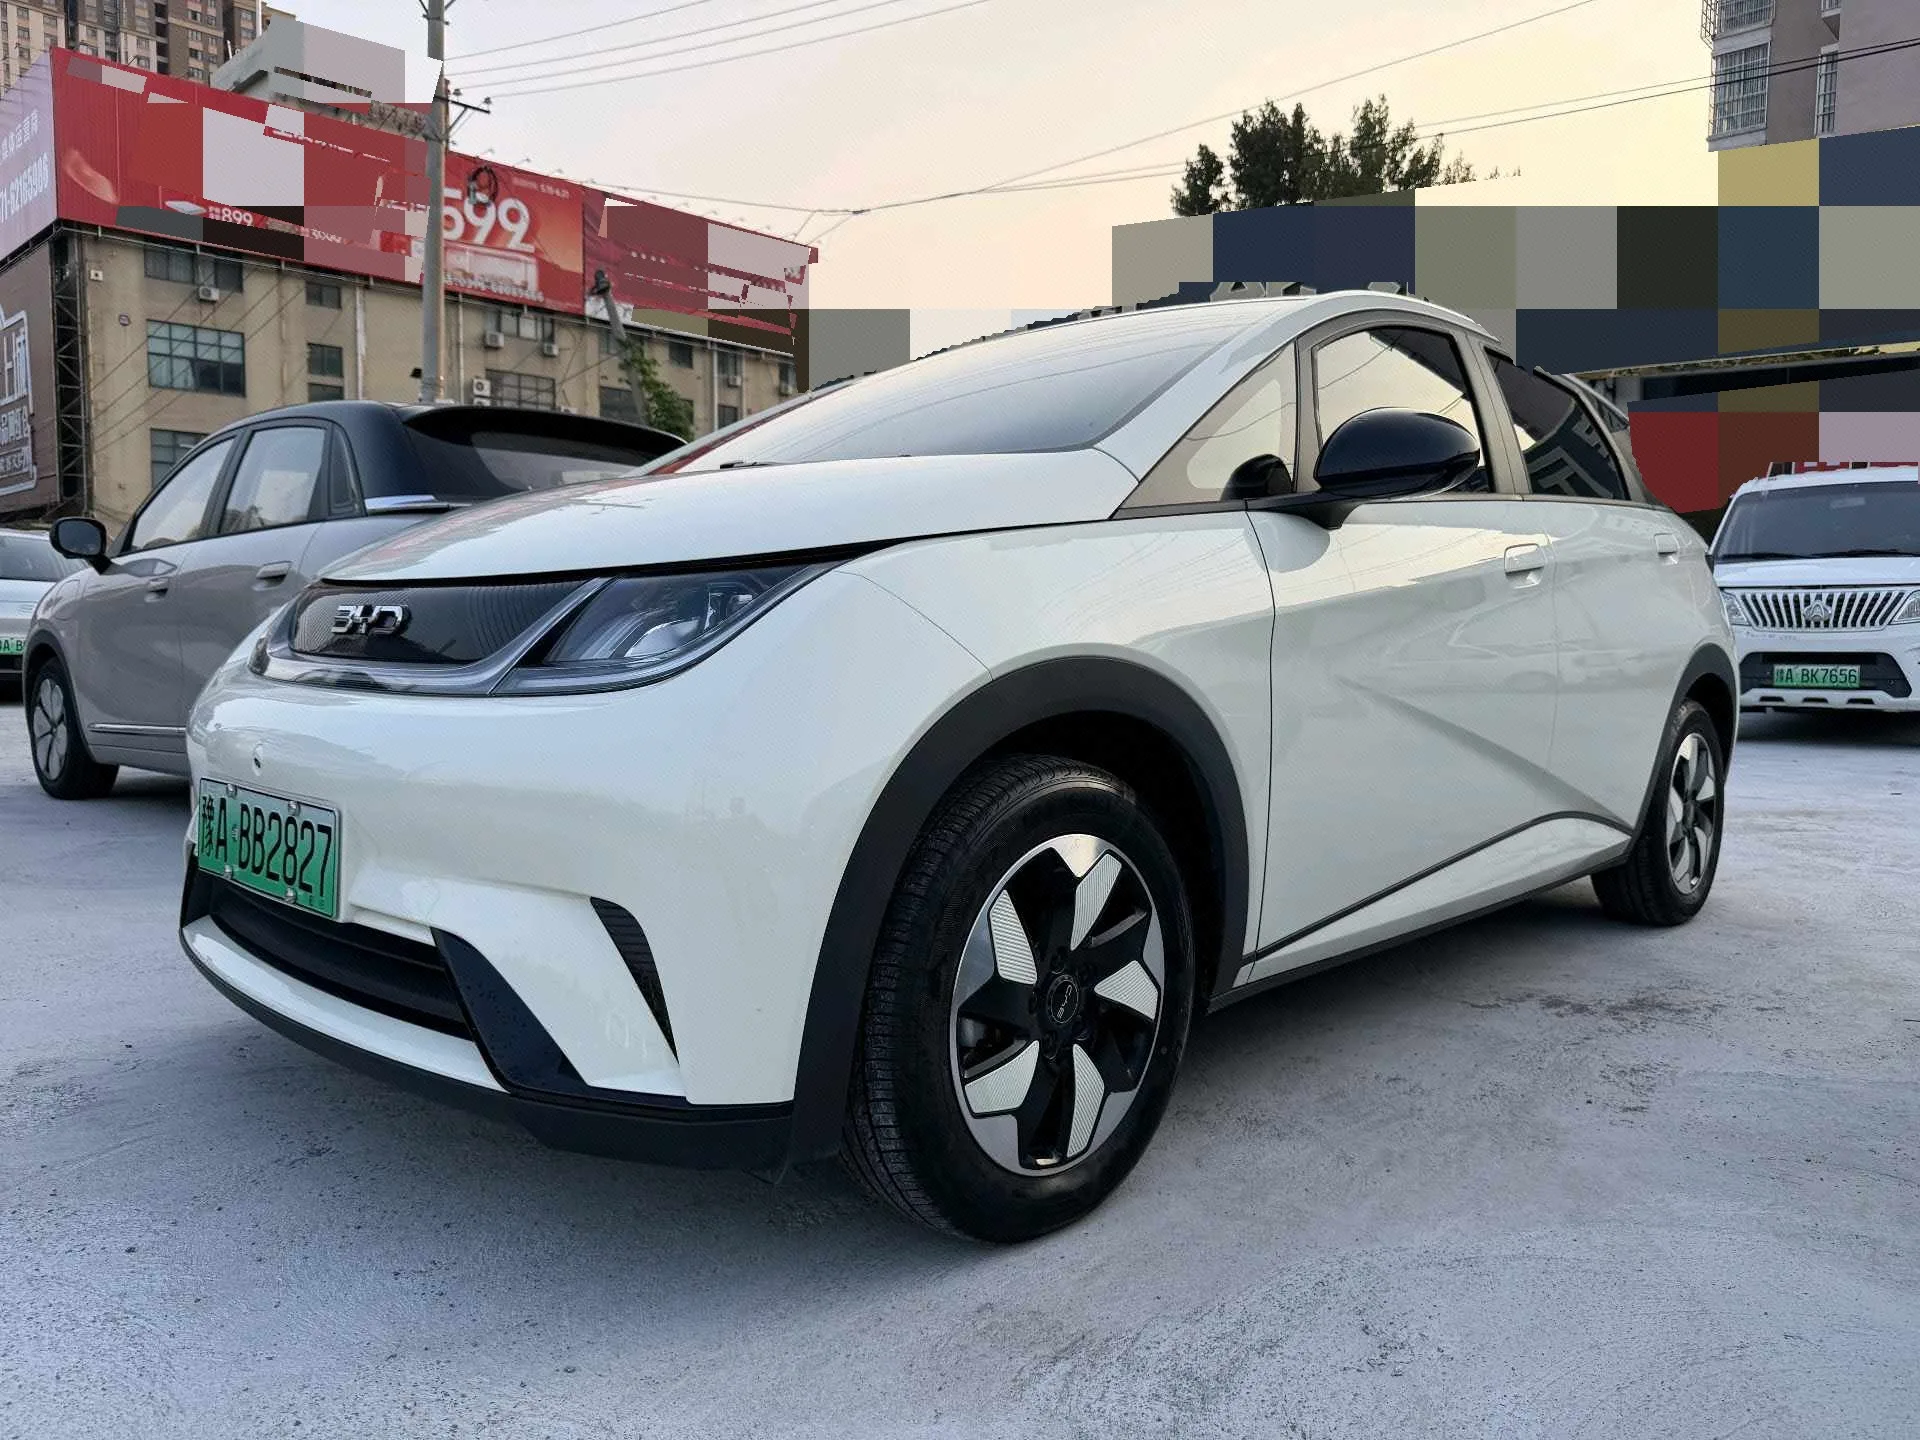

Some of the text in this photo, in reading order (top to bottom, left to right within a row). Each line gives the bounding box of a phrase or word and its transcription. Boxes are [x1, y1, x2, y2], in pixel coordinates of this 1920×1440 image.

[331, 605, 404, 634] BYD
[1800, 668, 1857, 684] BK7656
[239, 803, 332, 897] BB2827
